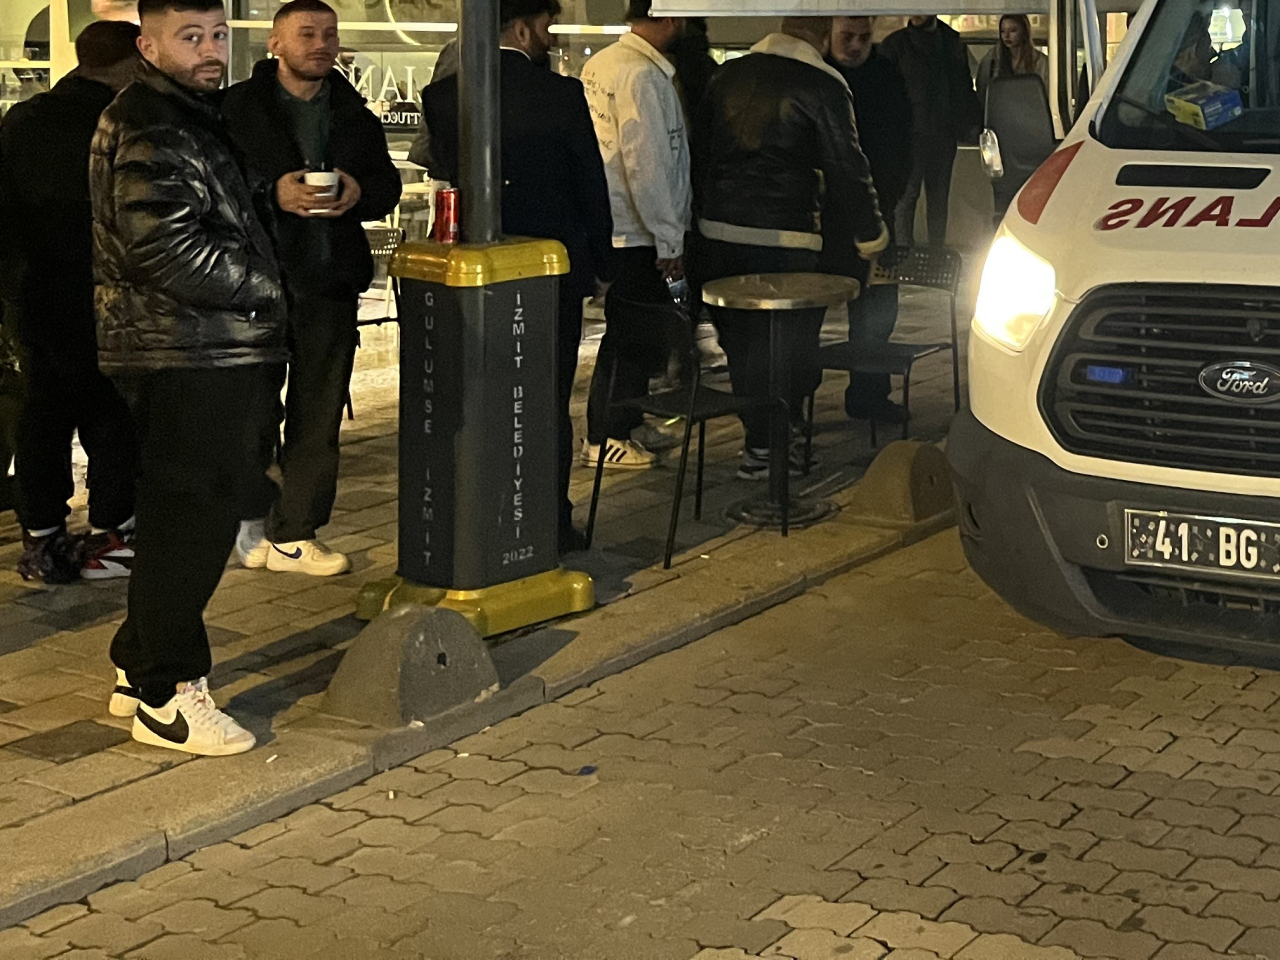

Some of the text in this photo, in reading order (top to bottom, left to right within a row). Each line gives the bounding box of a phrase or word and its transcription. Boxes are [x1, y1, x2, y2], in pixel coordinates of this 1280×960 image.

[1216, 368, 1270, 394] Ford
[502, 545, 534, 565] 2022
[1155, 520, 1189, 562] 41
[1219, 527, 1258, 568] BG
